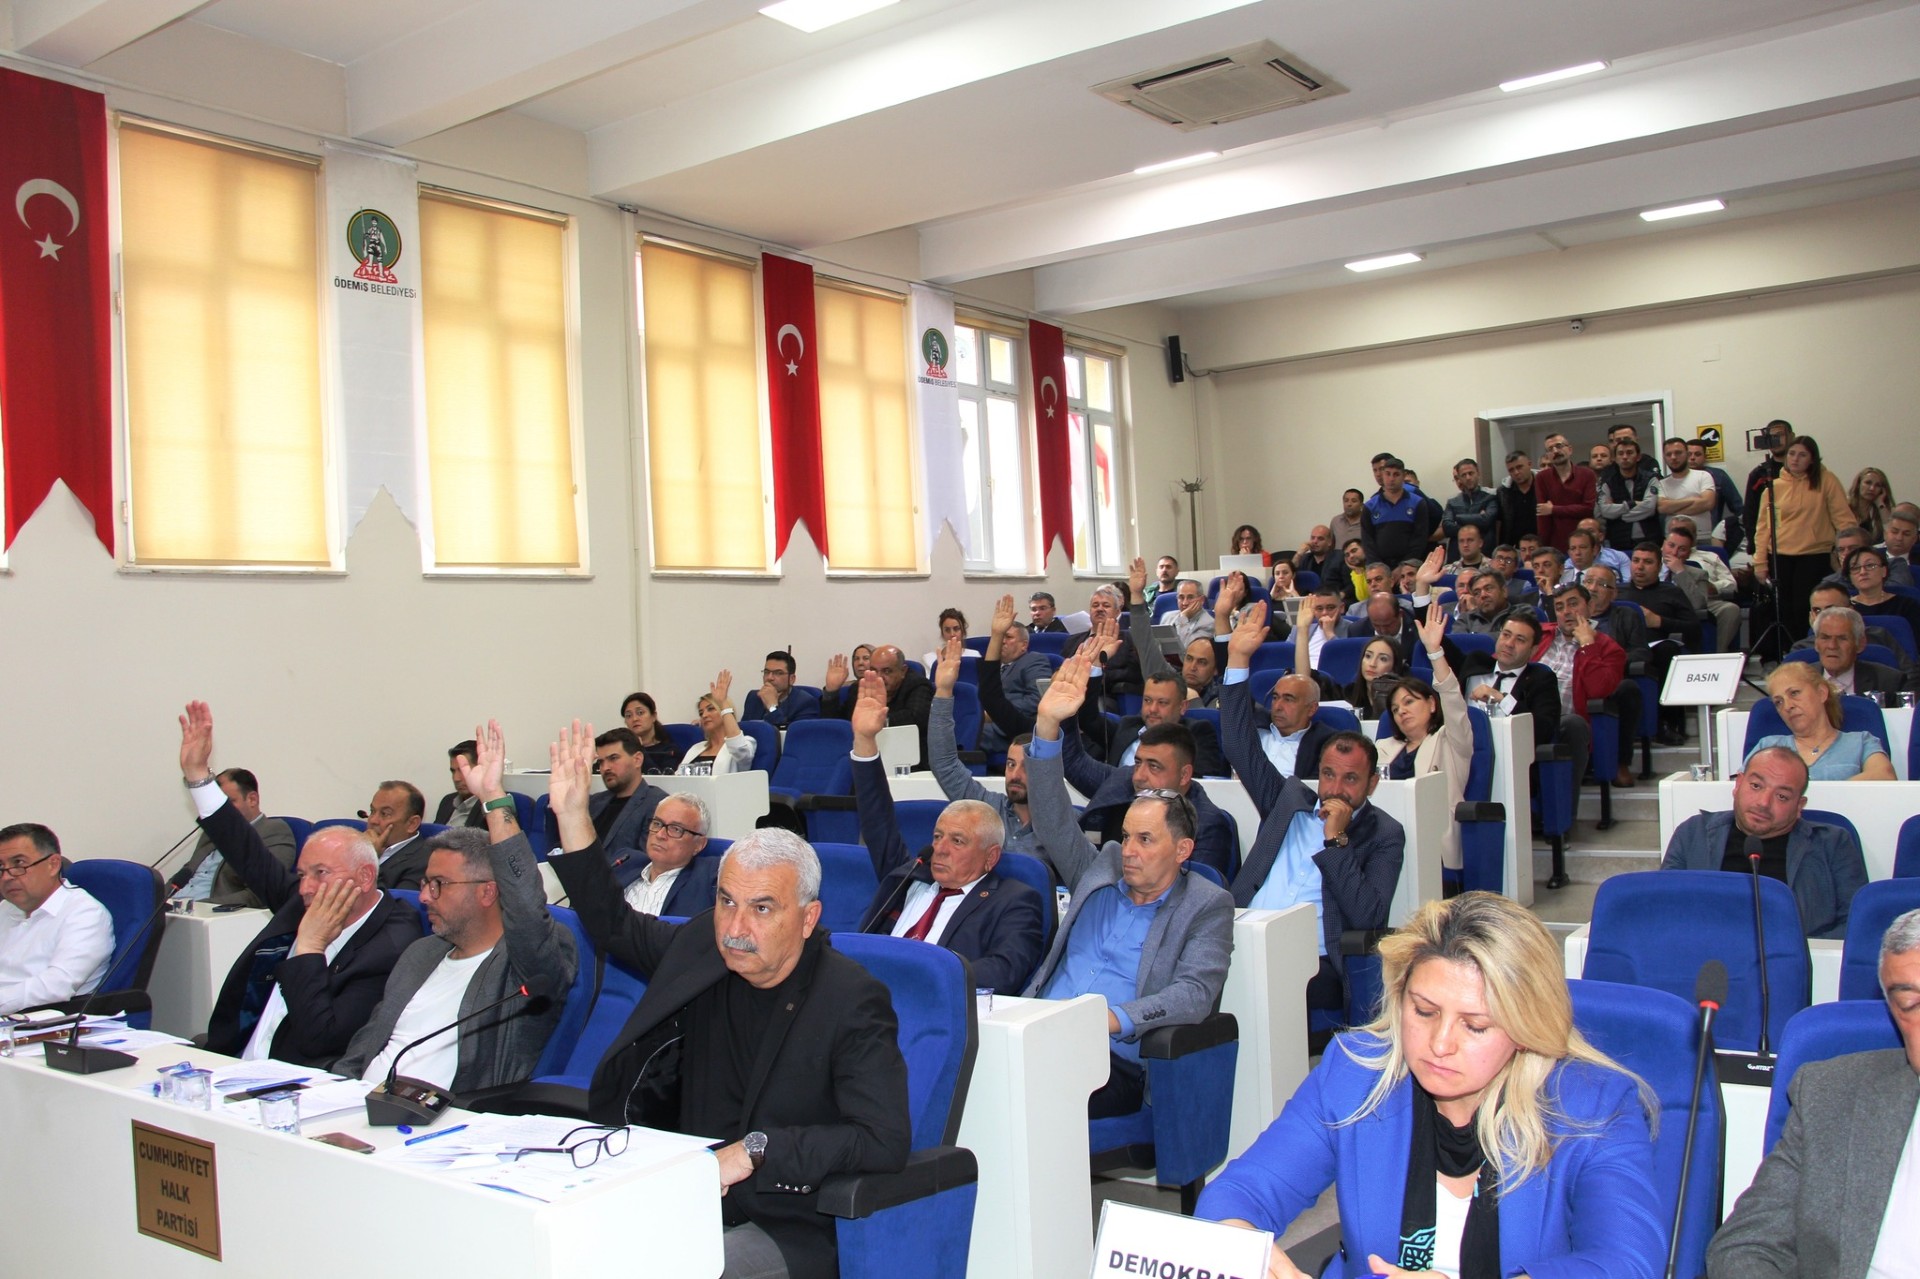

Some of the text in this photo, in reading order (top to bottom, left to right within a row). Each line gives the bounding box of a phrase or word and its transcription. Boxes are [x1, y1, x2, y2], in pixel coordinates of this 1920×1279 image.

[1686, 672, 1720, 682] BASIN
[139, 1141, 209, 1178] CUMHURİYET
[161, 1179, 191, 1204] HALK
[156, 1208, 198, 1239] PARTİSİ
[1109, 1250, 1245, 1279] DEMOKR
